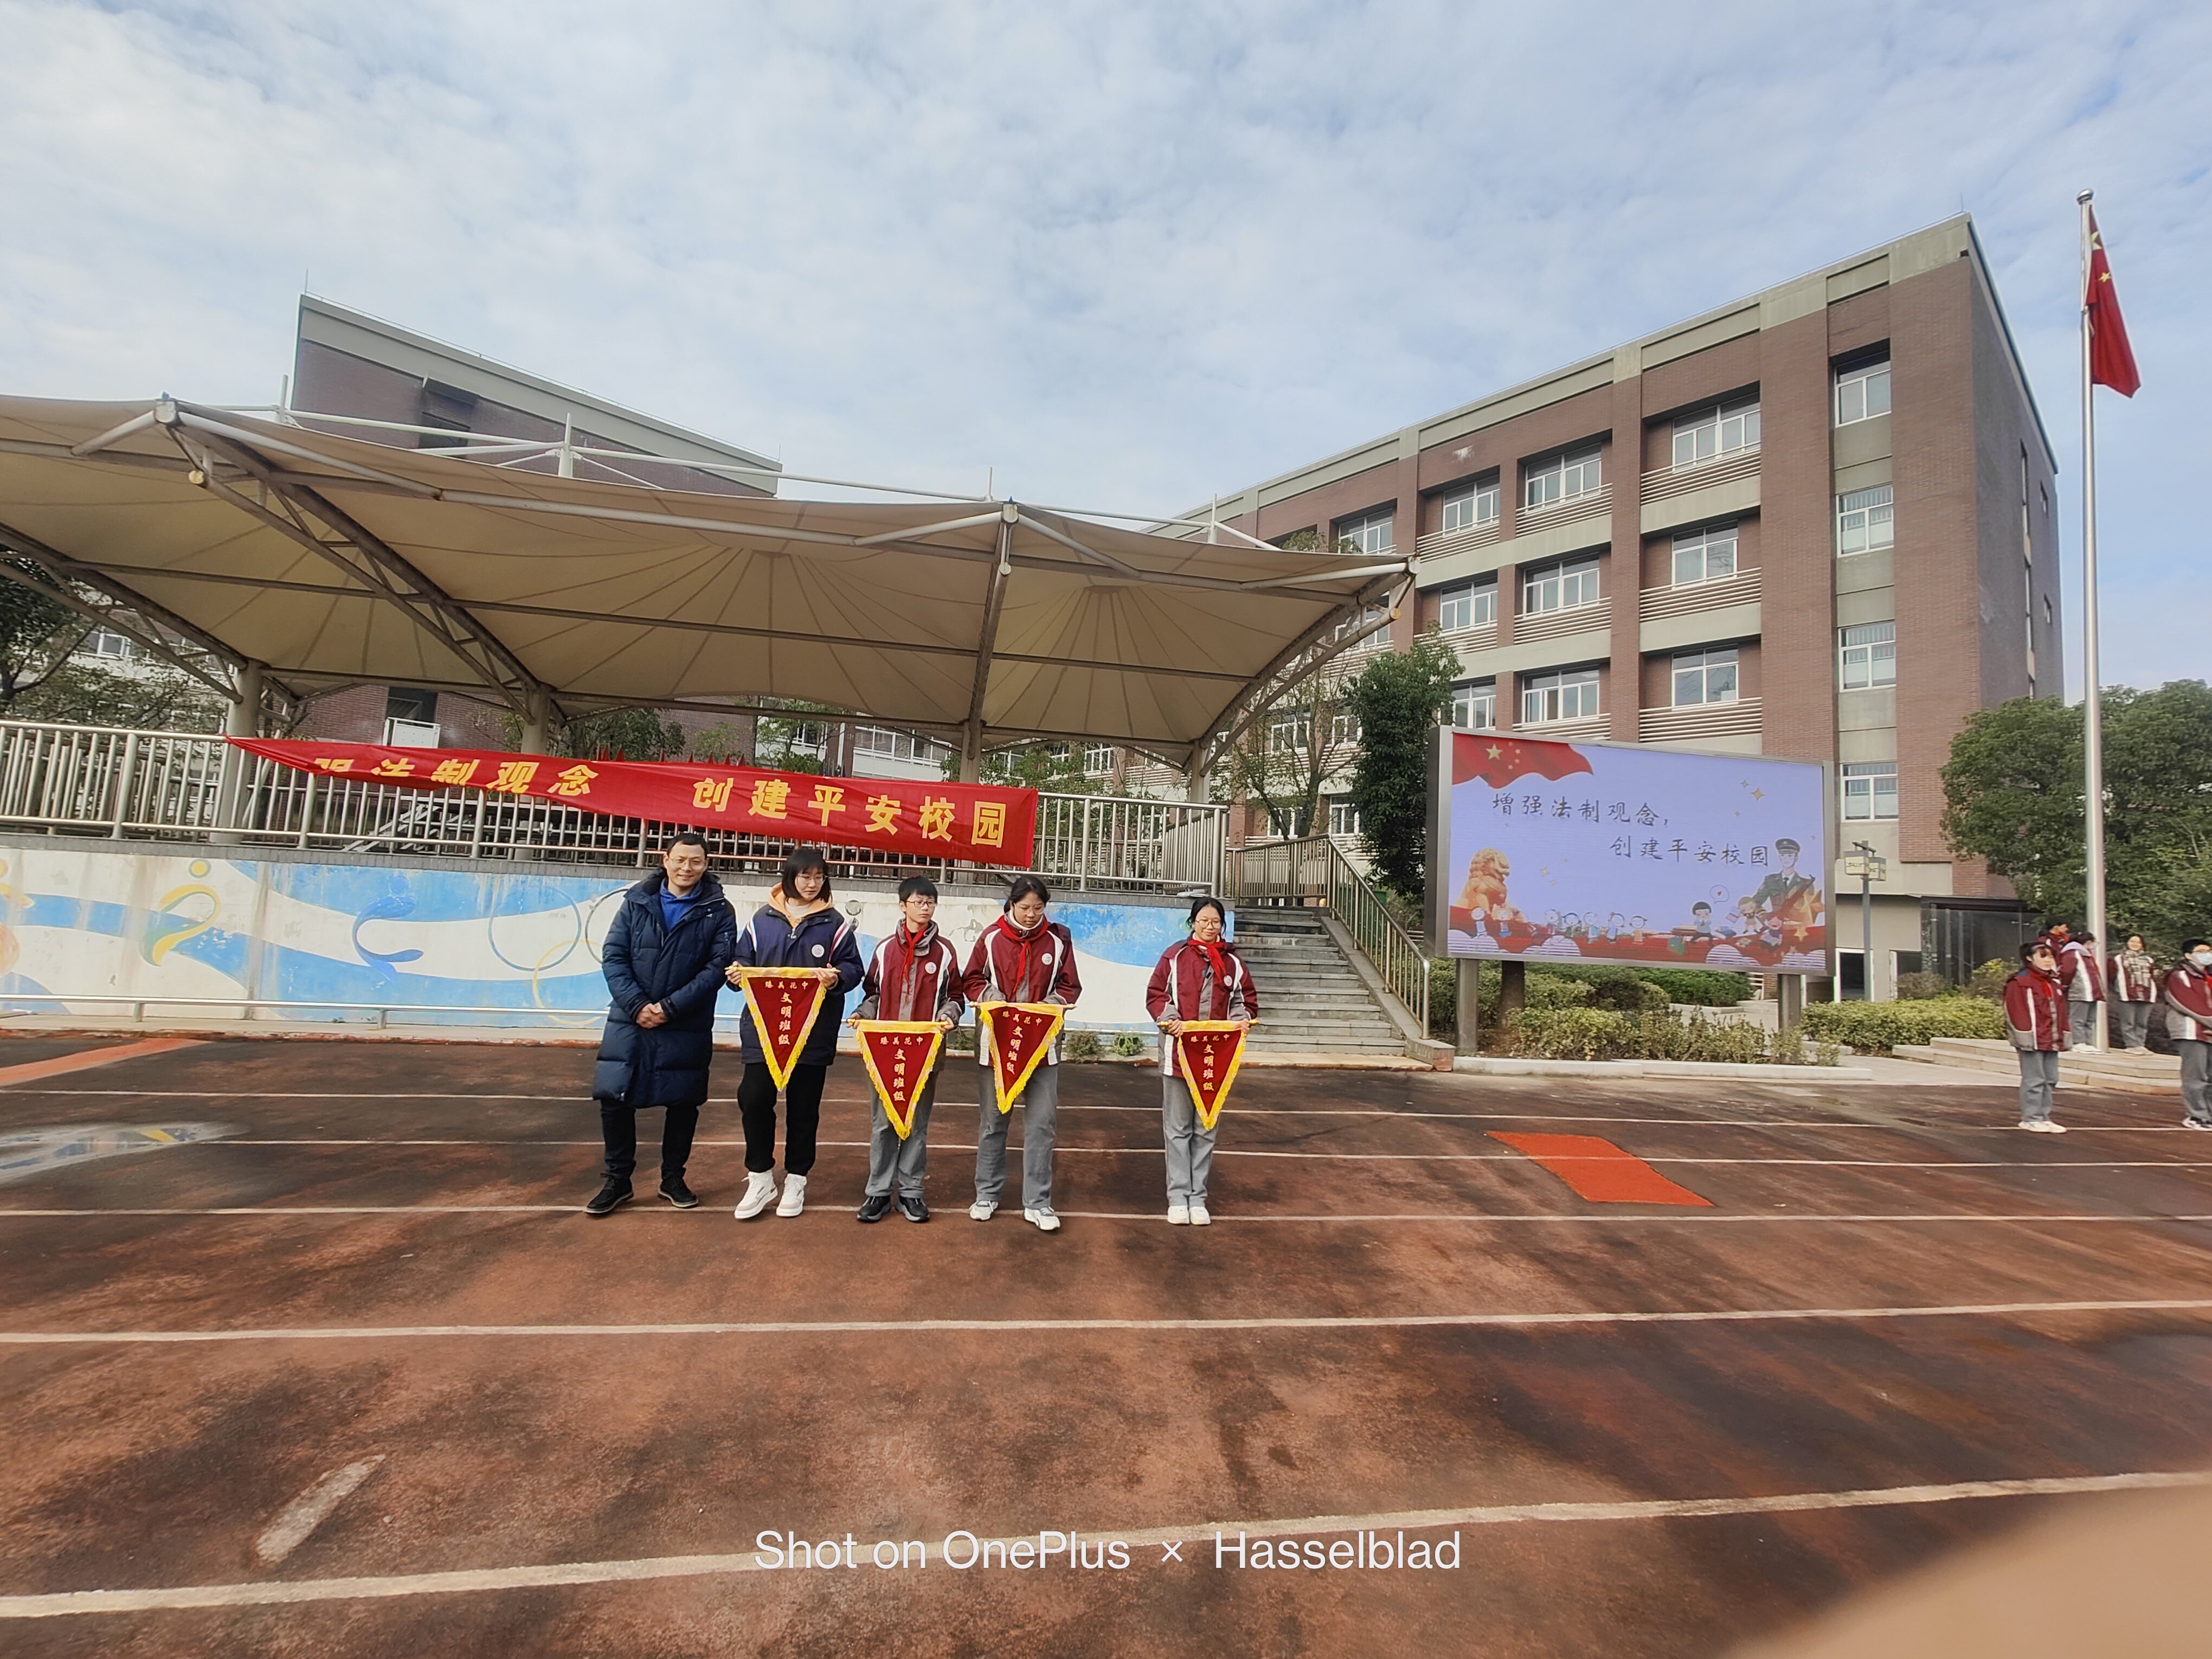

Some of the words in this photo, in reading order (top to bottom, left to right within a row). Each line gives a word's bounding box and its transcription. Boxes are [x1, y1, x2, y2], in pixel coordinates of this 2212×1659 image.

[692, 777, 1007, 848] 创建平安校园
[1609, 835, 1769, 867] 创建平安校园
[778, 992, 793, 1045] 文明班级
[893, 1048, 906, 1102] 文明班级
[1006, 1025, 1023, 1075] 文明班级
[1202, 1044, 1214, 1091] 文明班级
